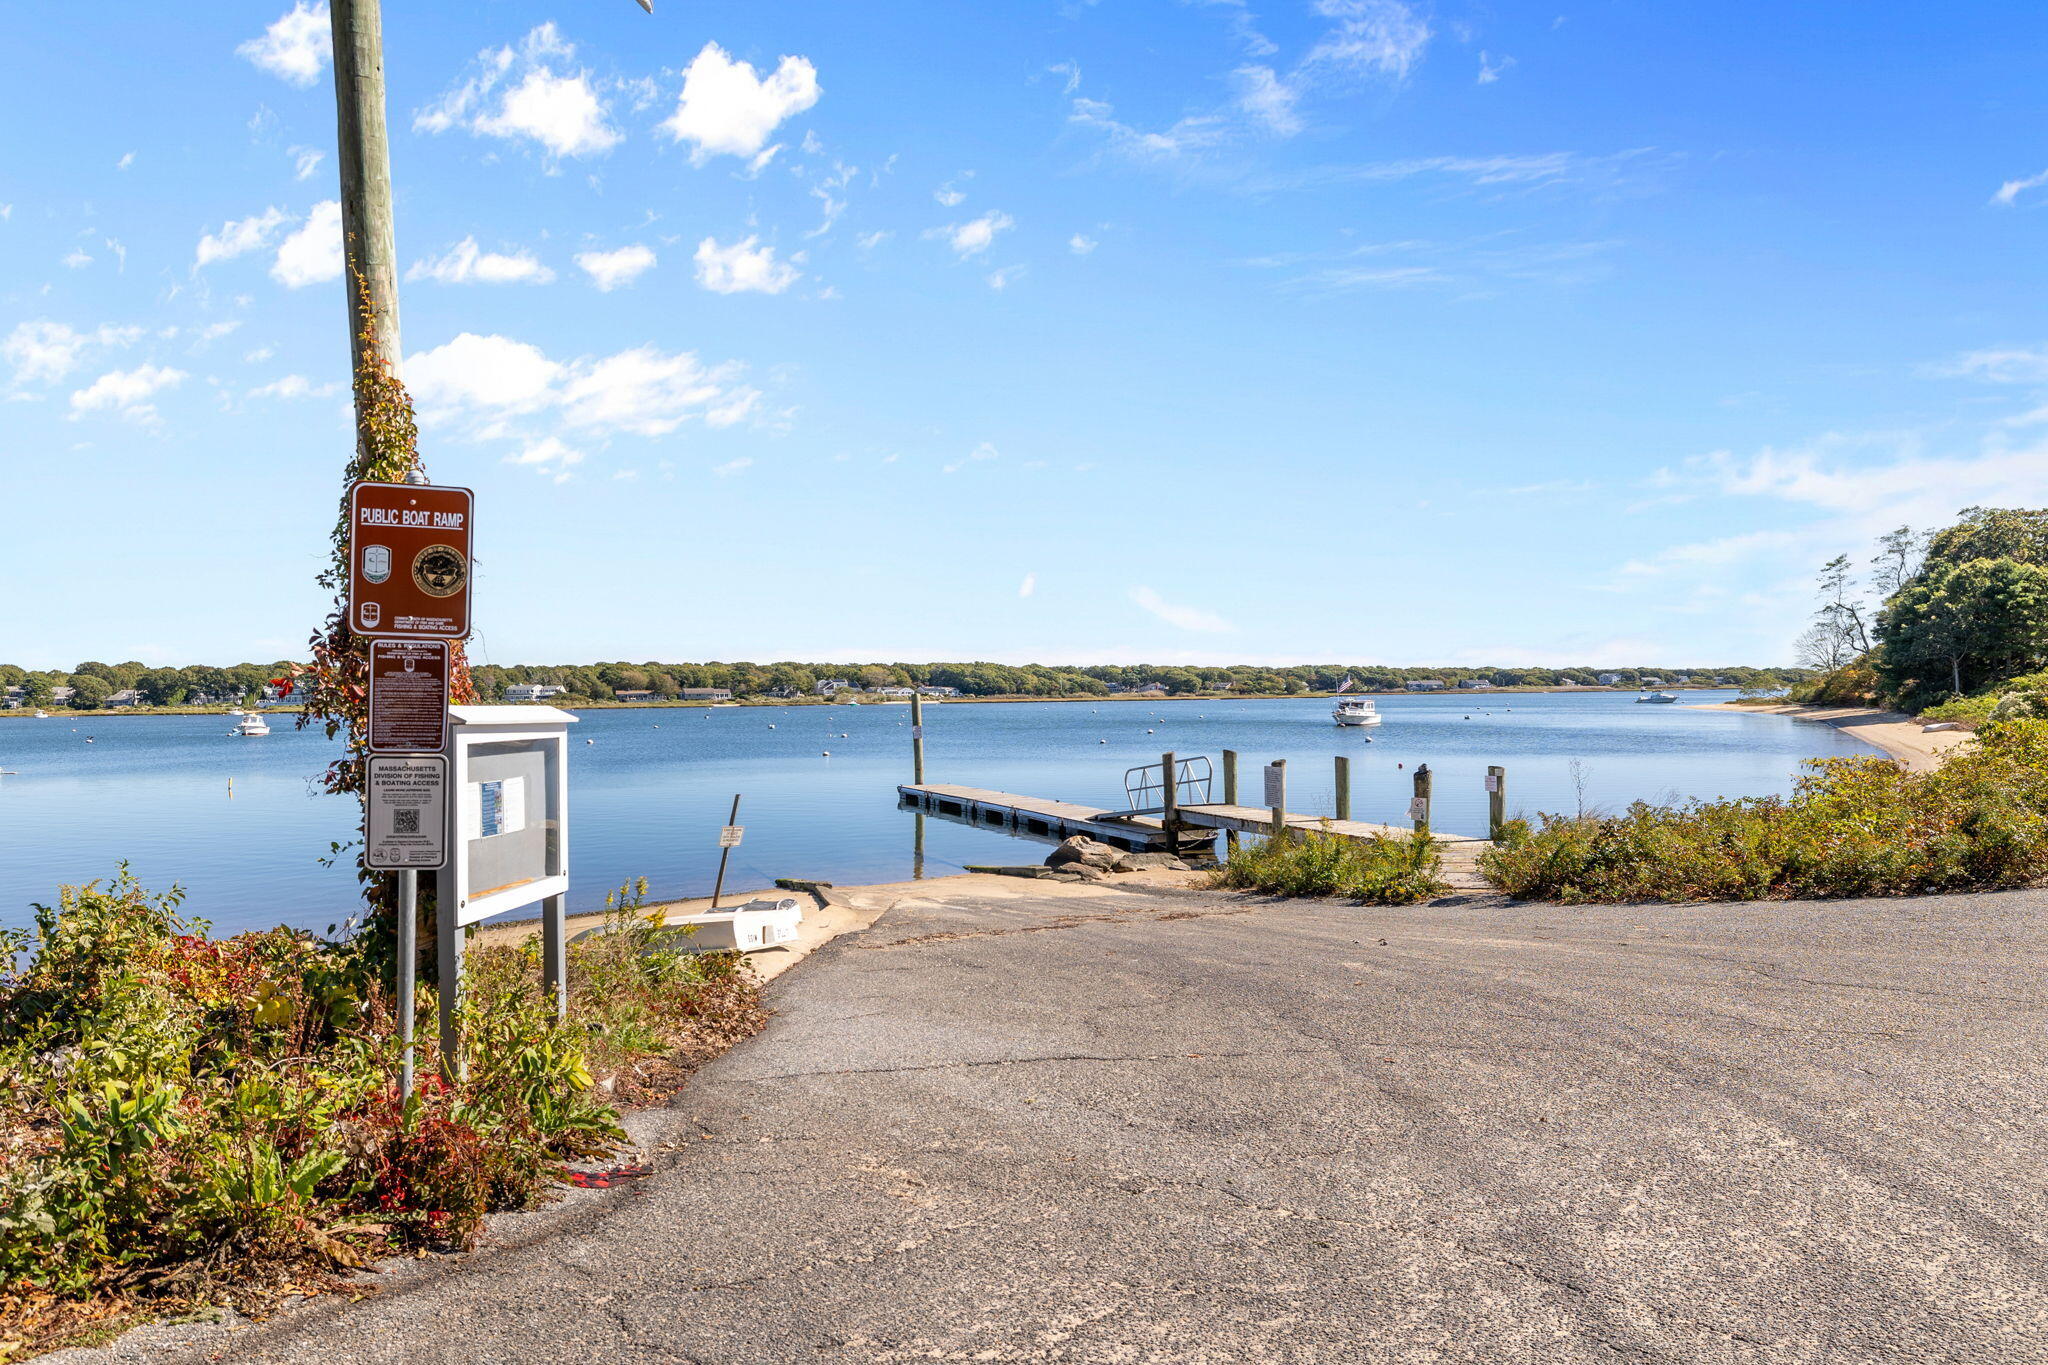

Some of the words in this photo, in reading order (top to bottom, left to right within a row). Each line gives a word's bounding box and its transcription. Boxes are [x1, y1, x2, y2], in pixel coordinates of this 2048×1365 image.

[360, 508, 398, 524] PUBLIC
[402, 510, 430, 526] BOAT
[434, 512, 464, 527] RAMP
